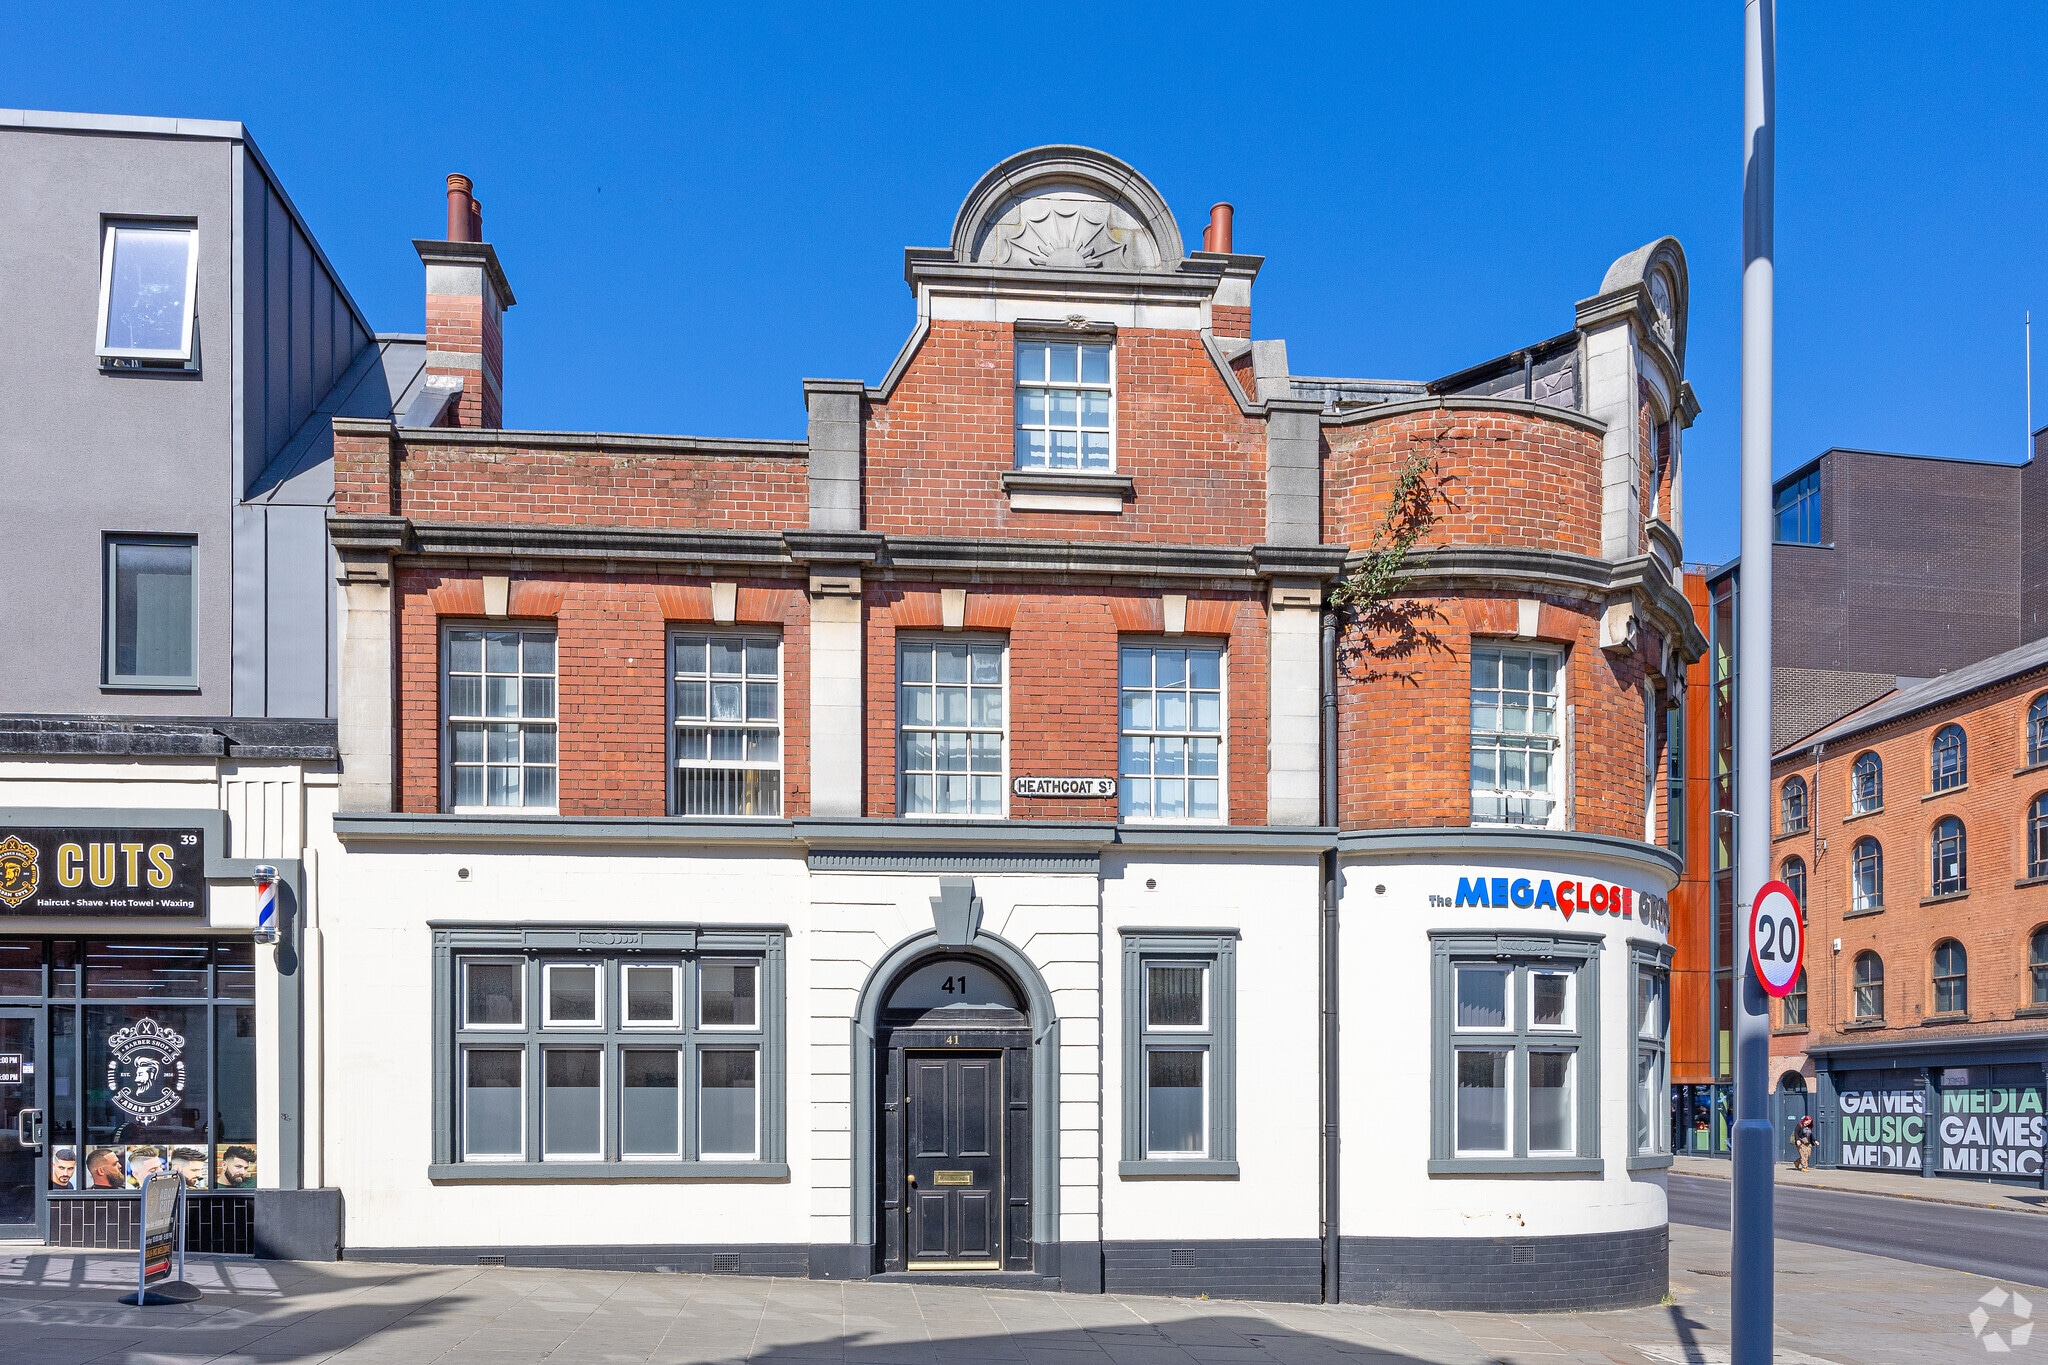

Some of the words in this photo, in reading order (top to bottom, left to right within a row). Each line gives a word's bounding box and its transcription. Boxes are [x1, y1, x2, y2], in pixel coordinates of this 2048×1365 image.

[1018, 780, 1094, 793] HEATHCOAT
[1098, 781, 1113, 793] ST
[180, 835, 198, 845] 39
[57, 842, 174, 889] CUTS
[37, 899, 70, 907] Haircut
[76, 899, 104, 907] Shave
[110, 899, 127, 907] Hot
[128, 899, 154, 907] Towel
[161, 899, 195, 908] Waxing
[1428, 894, 1453, 908] The
[1455, 877, 1633, 920] MEGACLOSE
[1758, 914, 1796, 963] 20
[941, 975, 966, 995] 41
[125, 1039, 151, 1051] BARBER
[152, 1039, 170, 1051] SHOP
[946, 1035, 960, 1045] 41
[121, 1099, 146, 1113] ADAM
[150, 1099, 172, 1113] CUTS
[1839, 1090, 1926, 1114] GAMES
[1943, 1087, 2043, 1114] MEDIA
[1842, 1115, 1925, 1144] MUSIC
[1939, 1115, 2048, 1148] GAMES
[1842, 1144, 1922, 1168] MEDIA
[1943, 1147, 2044, 1174] MUSIC
